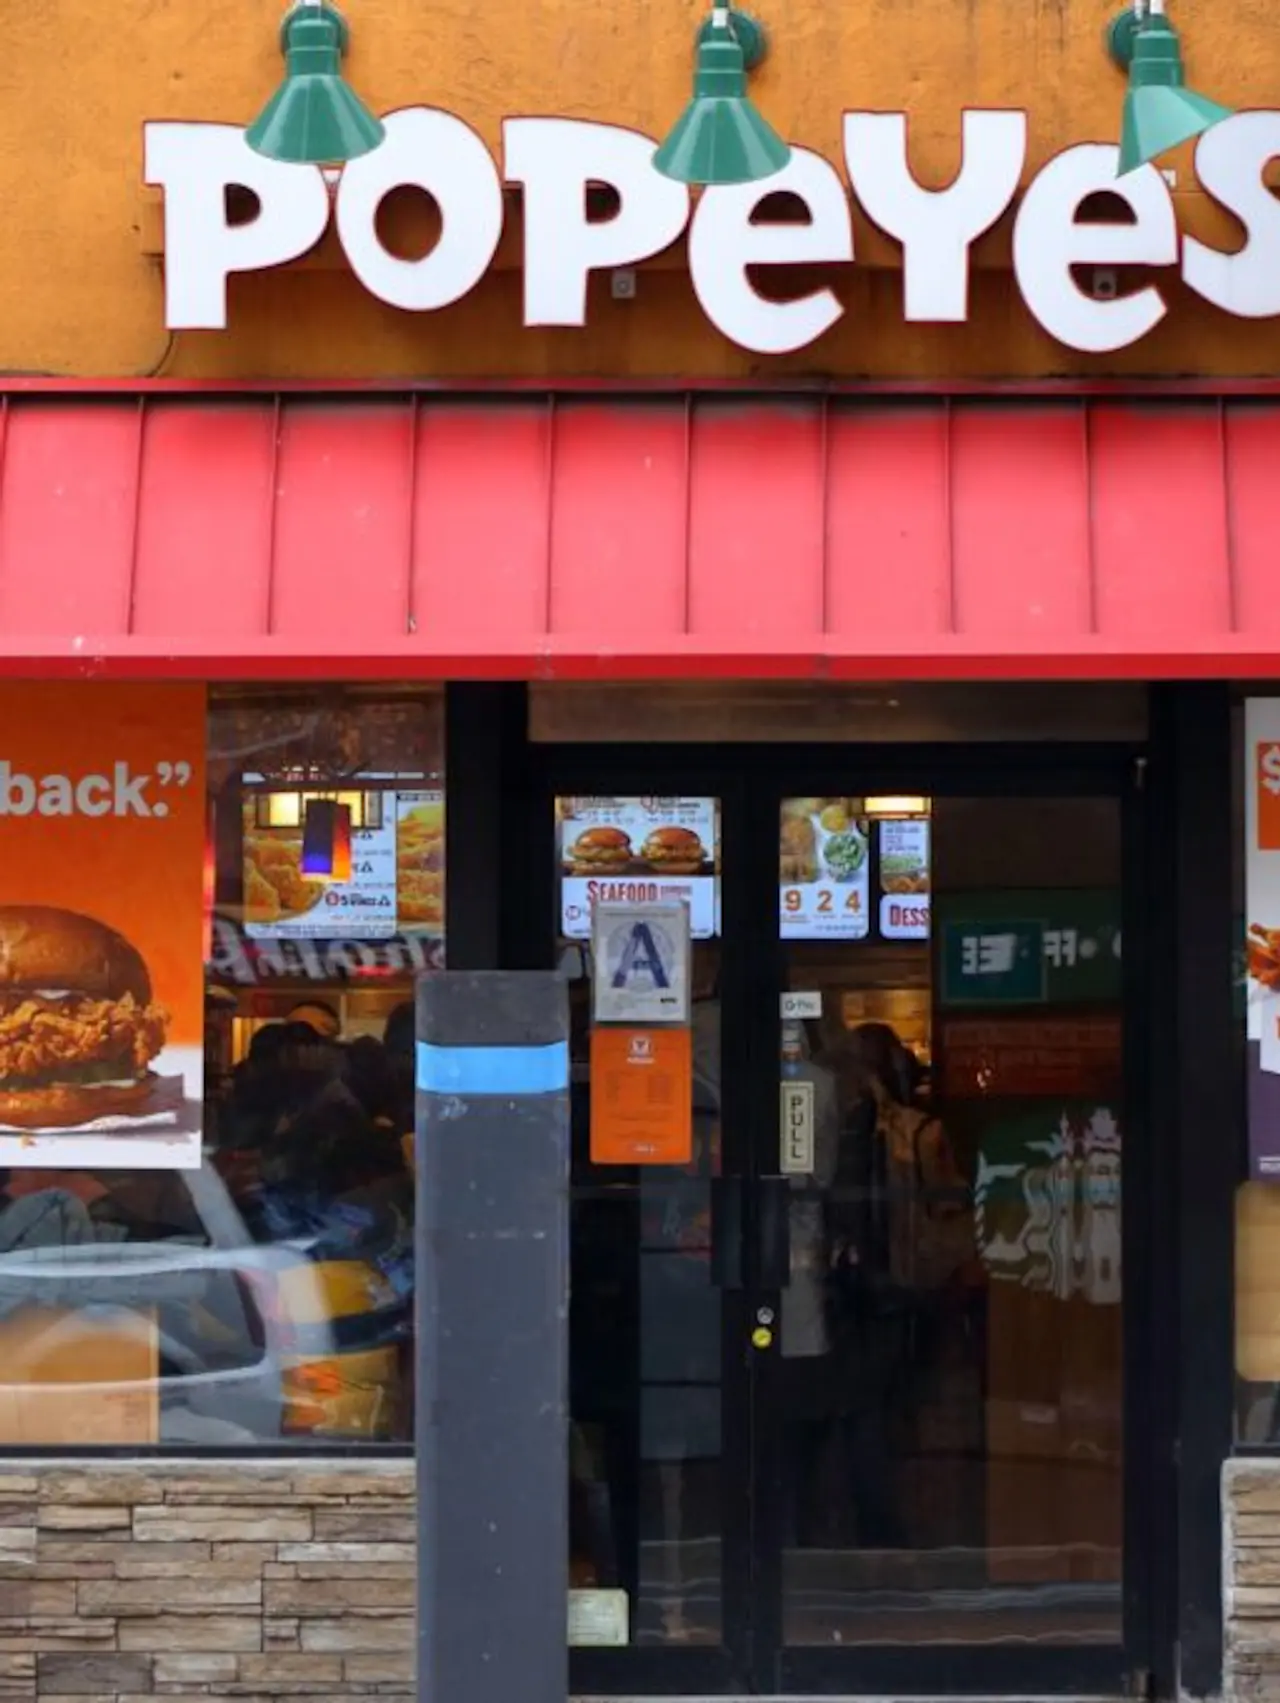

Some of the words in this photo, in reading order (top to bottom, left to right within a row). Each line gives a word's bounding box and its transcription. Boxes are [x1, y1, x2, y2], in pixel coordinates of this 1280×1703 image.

[587, 880, 658, 902] SEAFOOD
[785, 889, 801, 912] 9
[817, 889, 833, 912] 2
[845, 889, 861, 913] 4
[612, 920, 670, 989] A
[790, 1095, 804, 1159] PULL
